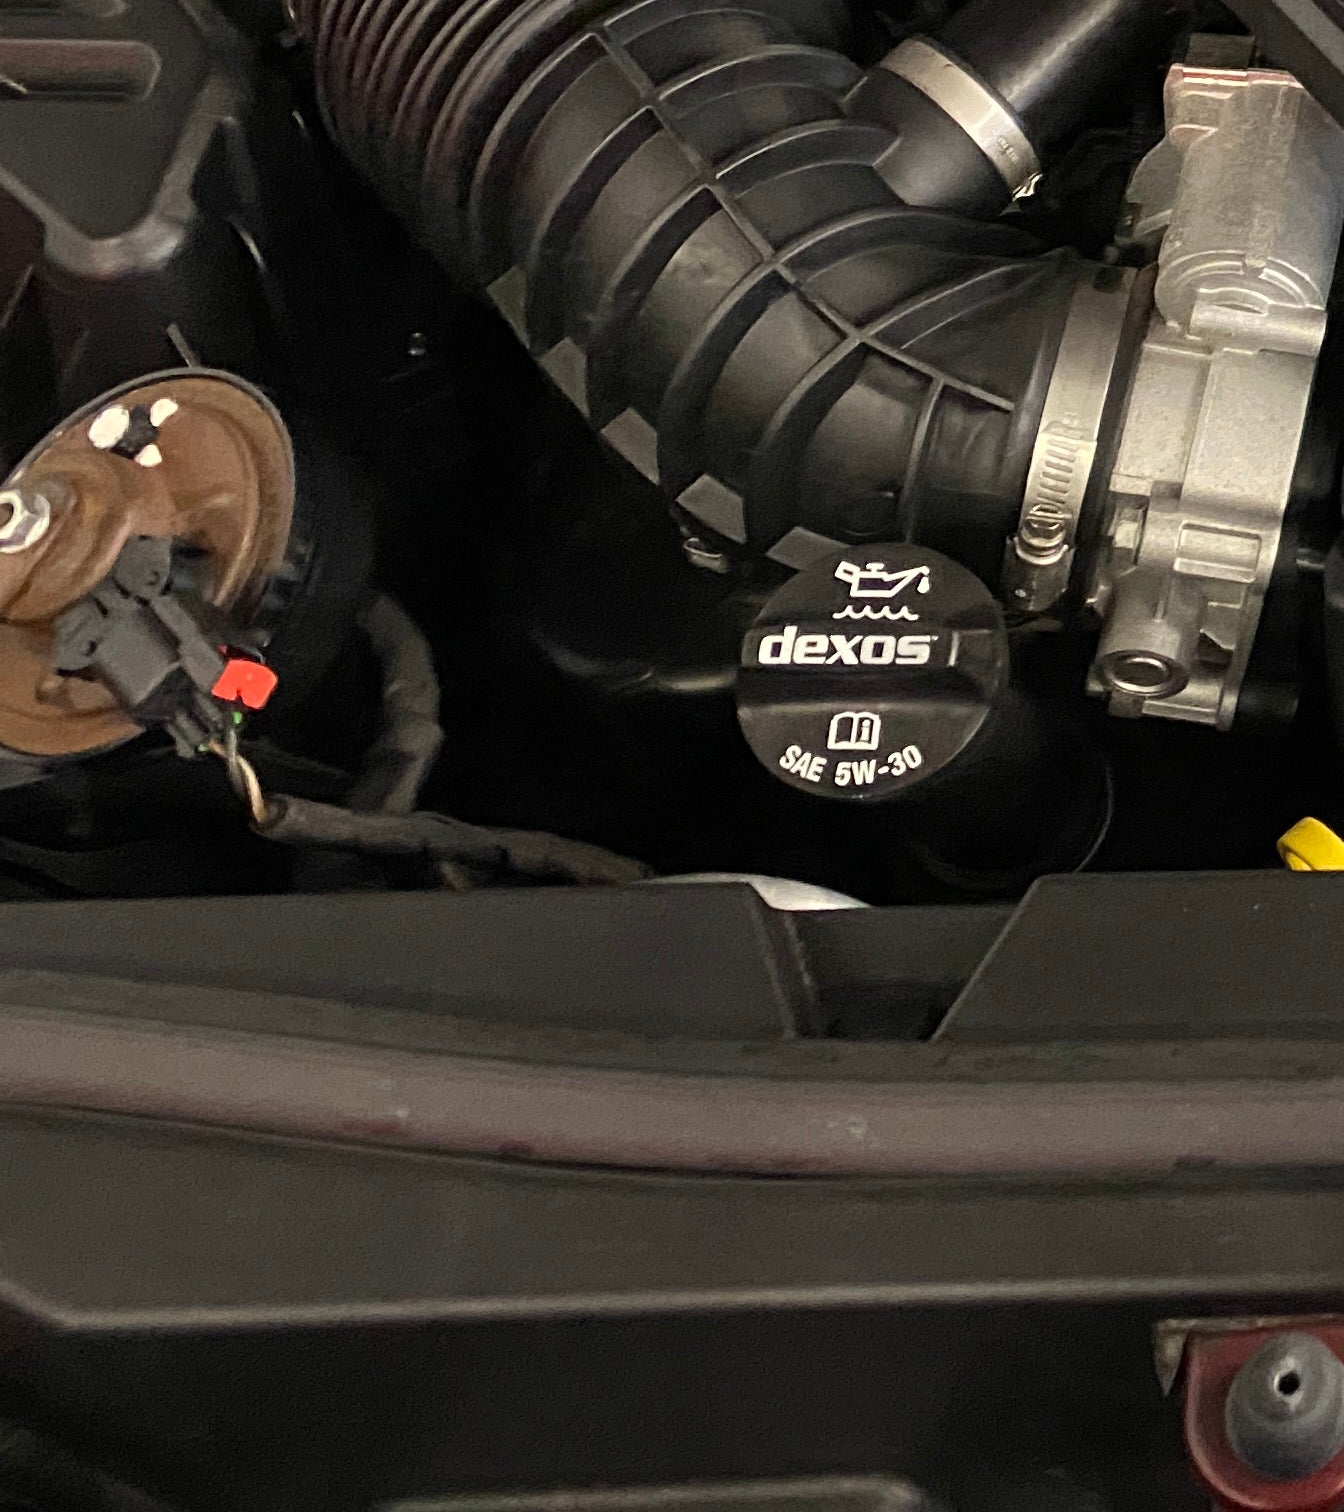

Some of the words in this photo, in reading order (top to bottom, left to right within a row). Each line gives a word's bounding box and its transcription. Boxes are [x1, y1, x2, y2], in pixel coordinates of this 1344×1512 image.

[758, 625, 931, 666] dexos
[779, 744, 828, 783] SAE
[834, 744, 923, 787] 5W-30
